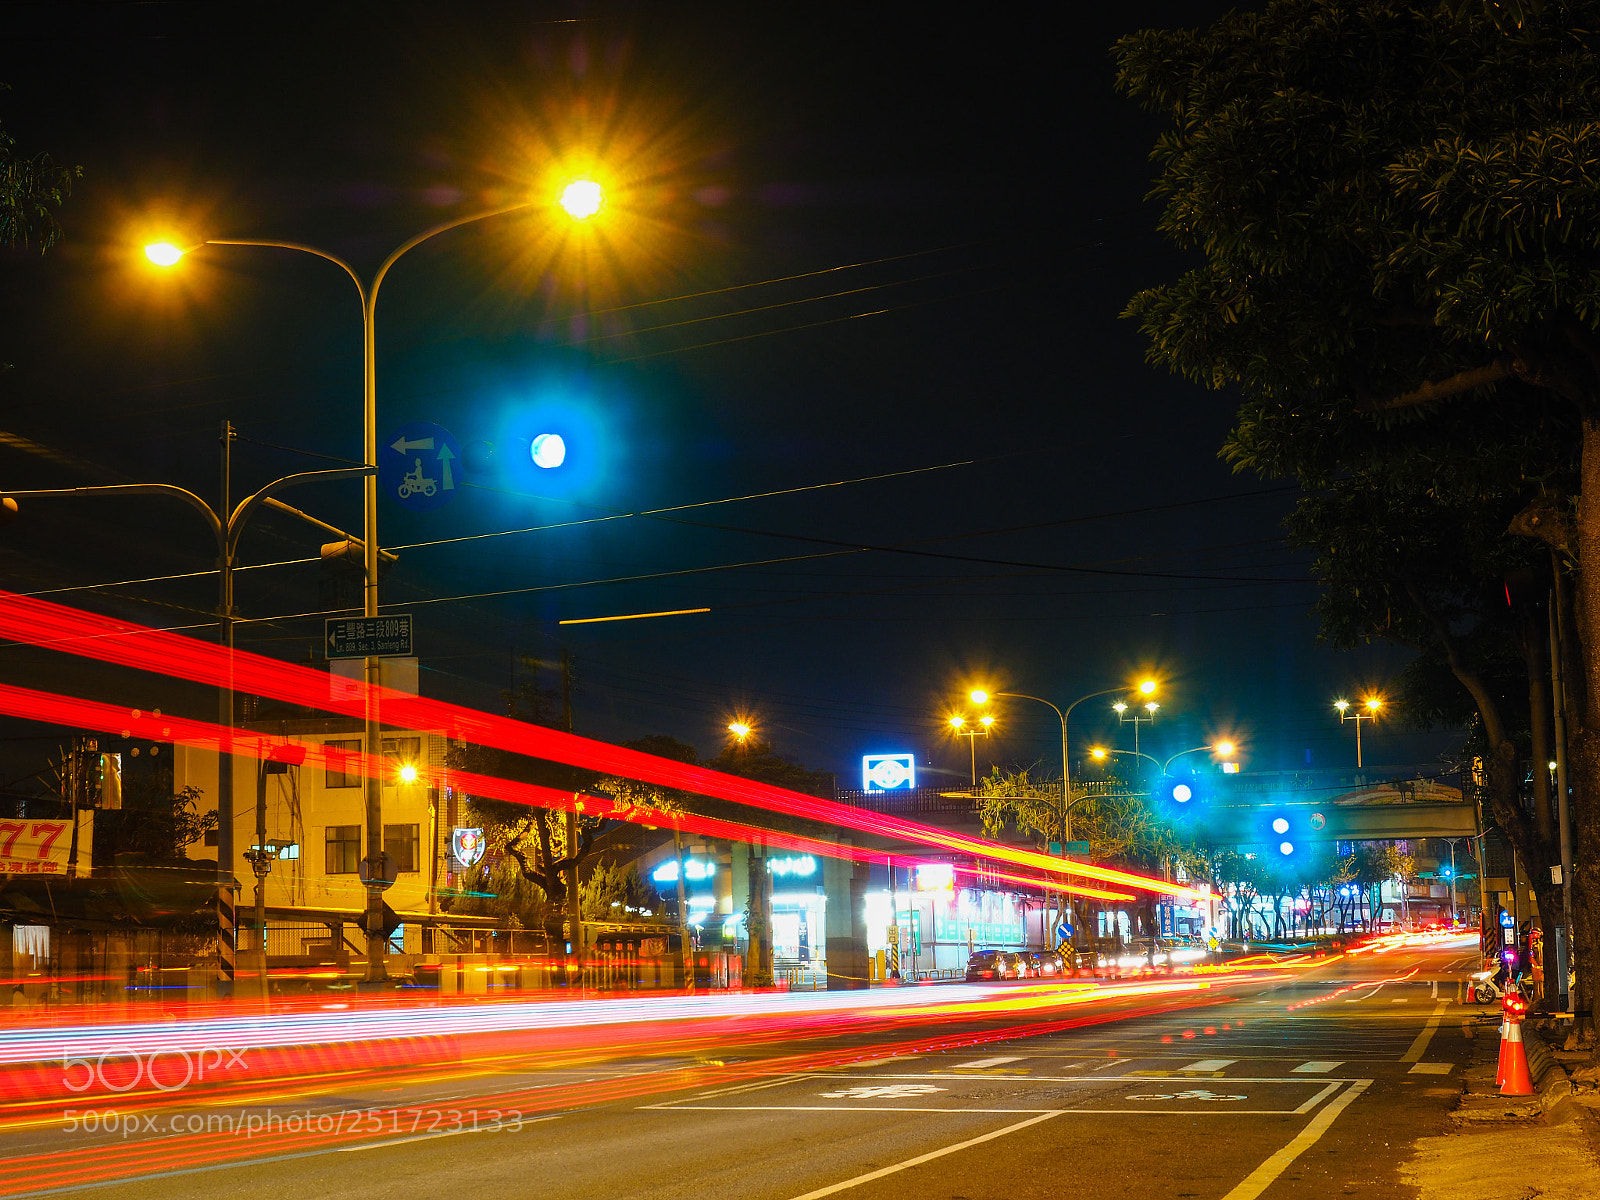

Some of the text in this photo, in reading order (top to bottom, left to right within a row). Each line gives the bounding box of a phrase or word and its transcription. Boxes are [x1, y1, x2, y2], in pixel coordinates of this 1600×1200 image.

[336, 619, 409, 640] 三豐路三段809巷
[377, 640, 399, 652] Sanfeng
[889, 927, 896, 943] 出口
